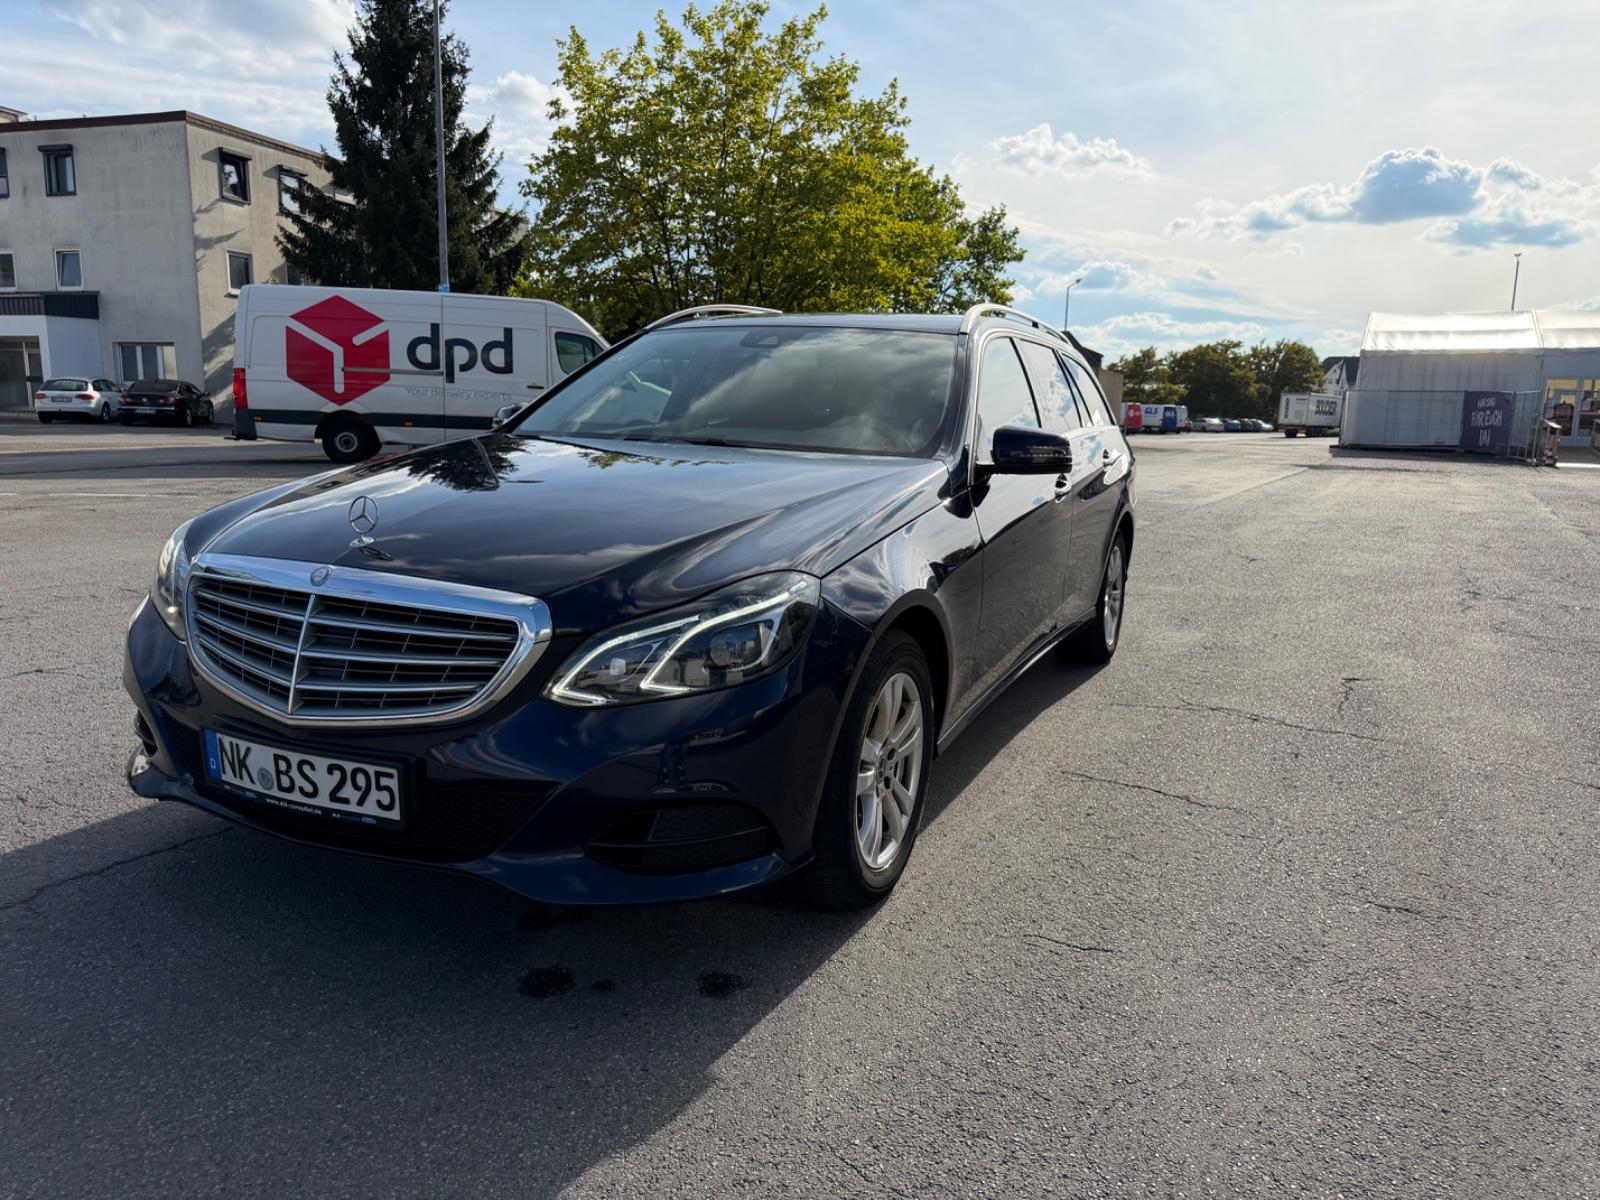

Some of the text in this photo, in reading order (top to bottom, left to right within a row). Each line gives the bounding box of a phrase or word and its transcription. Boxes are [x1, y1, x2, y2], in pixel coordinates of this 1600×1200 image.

[407, 323, 514, 383] dpd
[405, 385, 512, 401] Your delivery experts
[218, 736, 397, 812] NK BS 295
